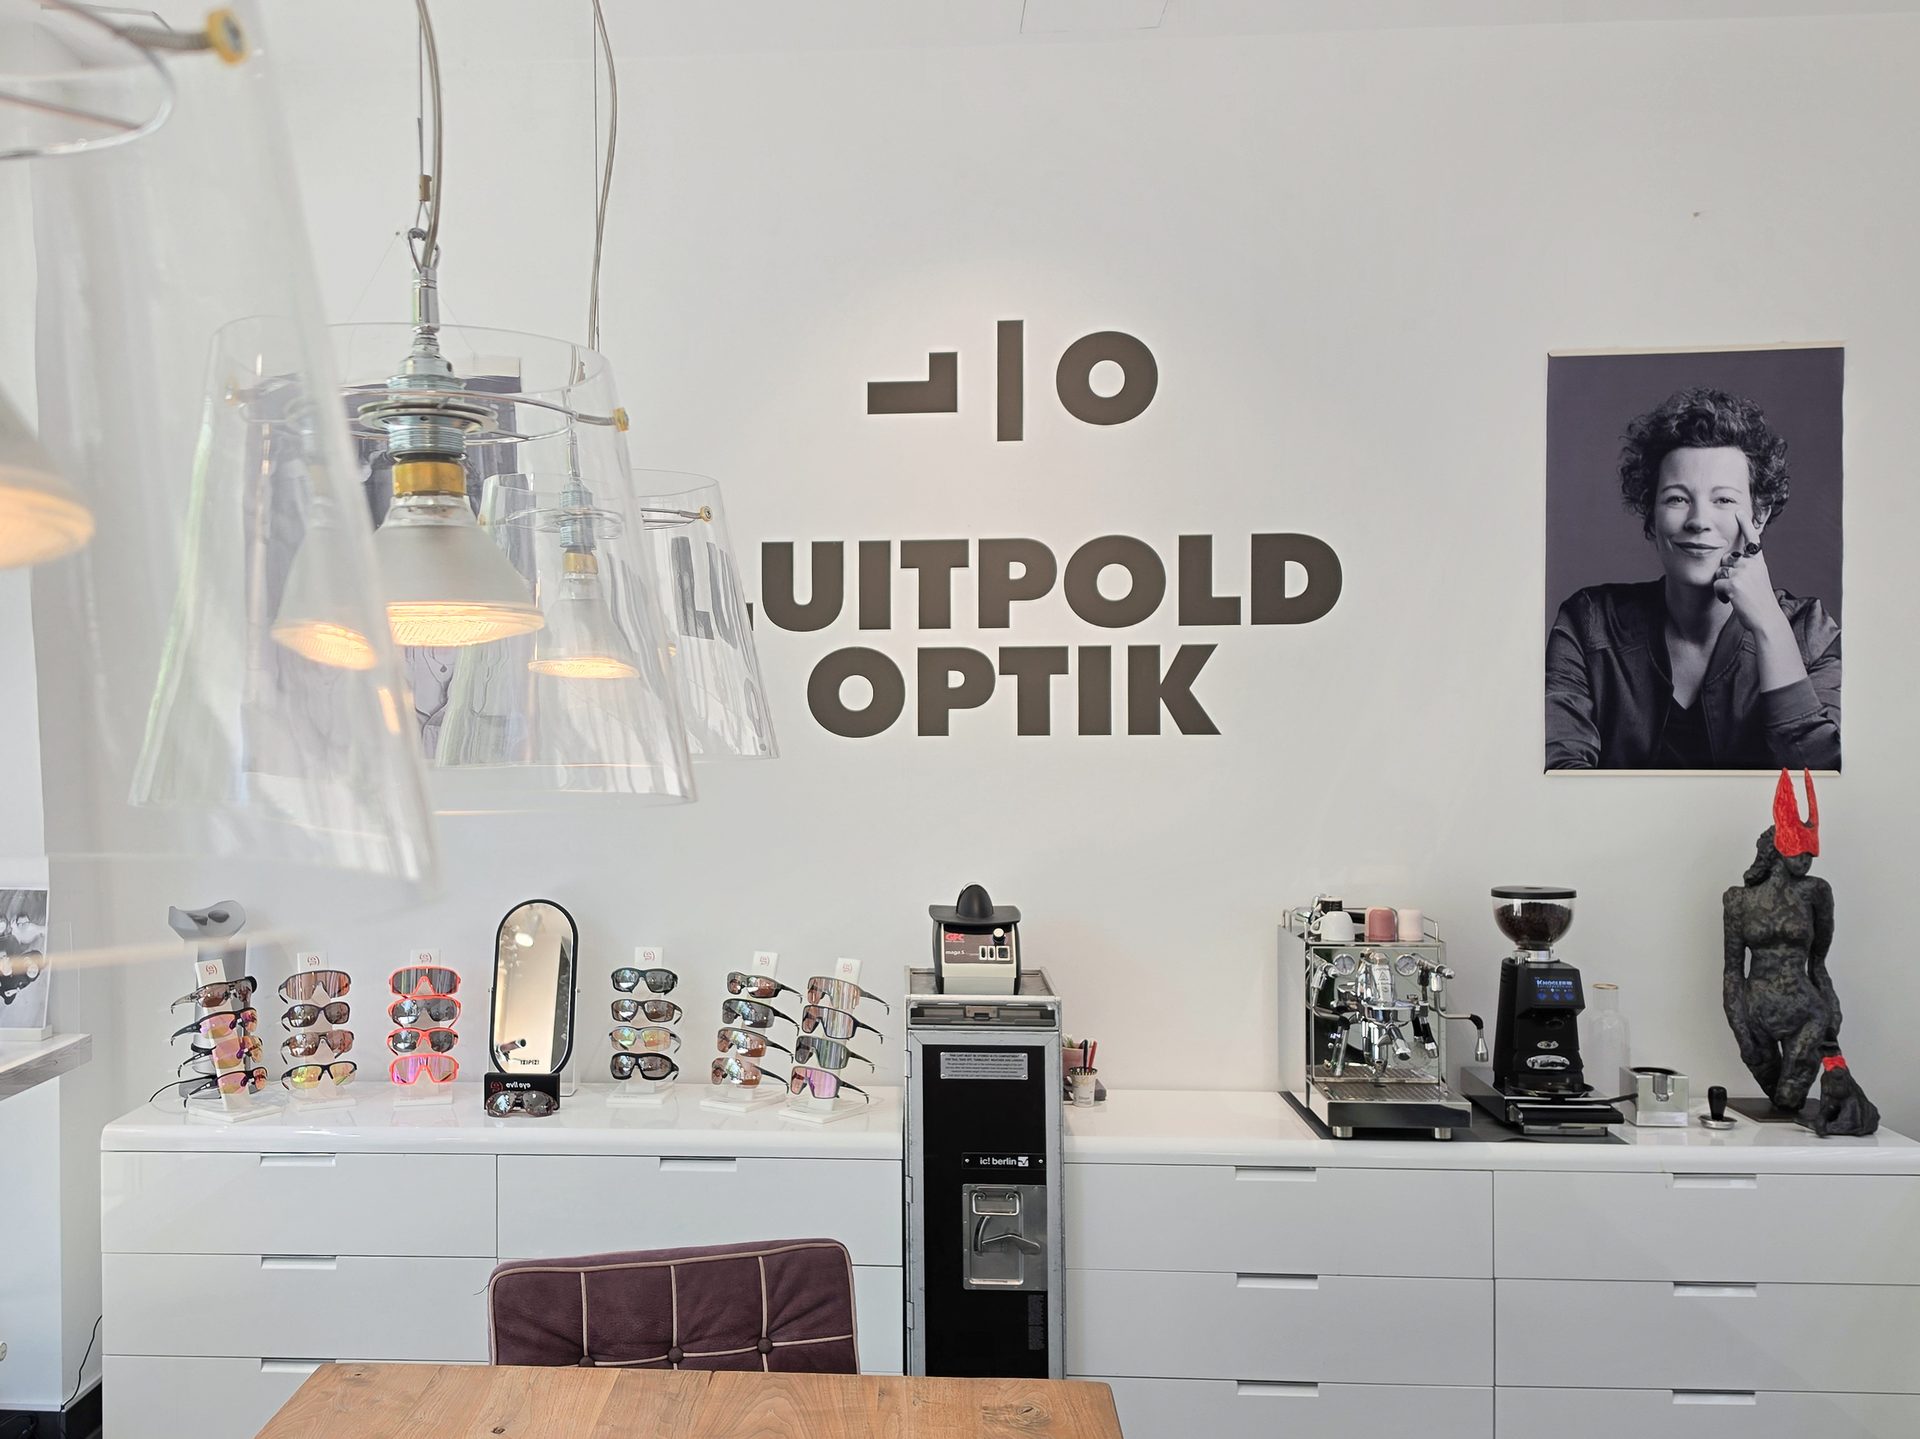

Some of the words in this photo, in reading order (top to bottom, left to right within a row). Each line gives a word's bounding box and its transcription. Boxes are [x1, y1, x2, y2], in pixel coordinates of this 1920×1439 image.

[807, 643, 1222, 738] OPTIK
[979, 1157, 991, 1165] ic!
[992, 1157, 1017, 1165] berlin
